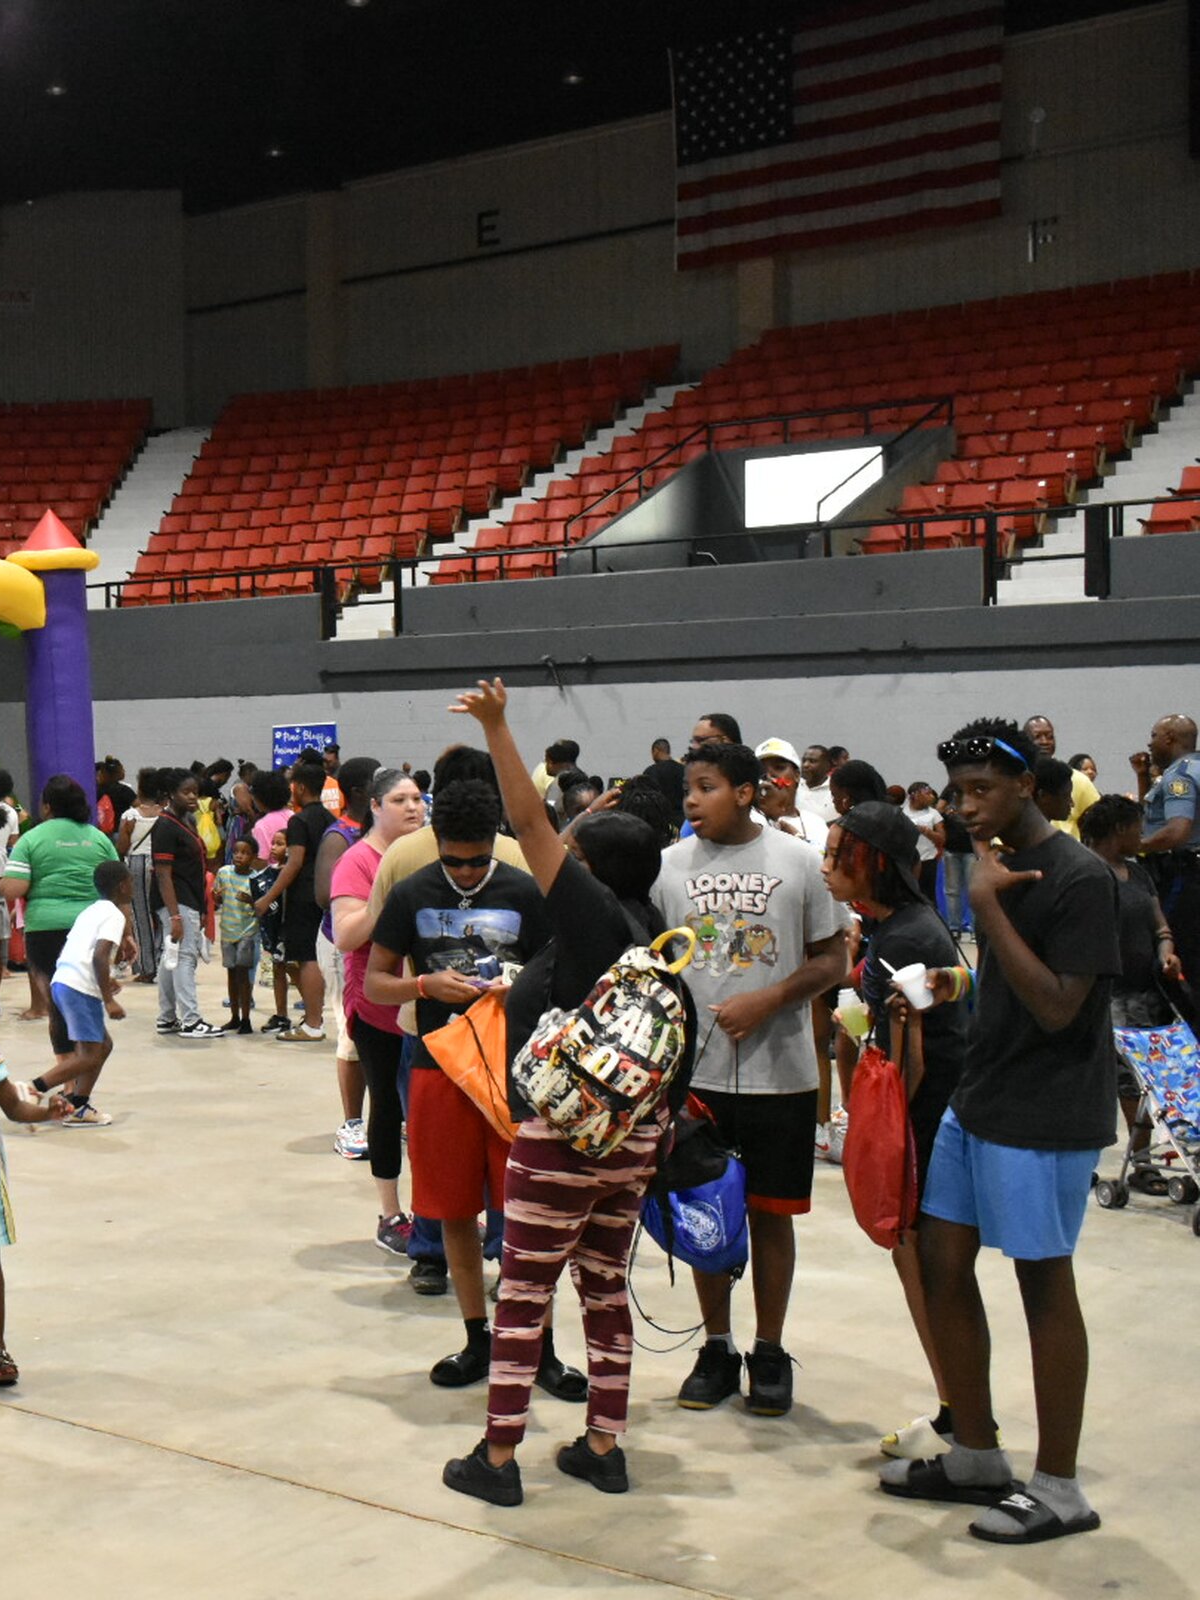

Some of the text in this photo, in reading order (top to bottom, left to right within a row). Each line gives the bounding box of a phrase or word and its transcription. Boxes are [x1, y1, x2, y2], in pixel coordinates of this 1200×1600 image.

[477, 208, 501, 248] E
[686, 872, 782, 899] LOONEY
[693, 891, 767, 915] TUNES
[592, 986, 671, 1065] CALI
